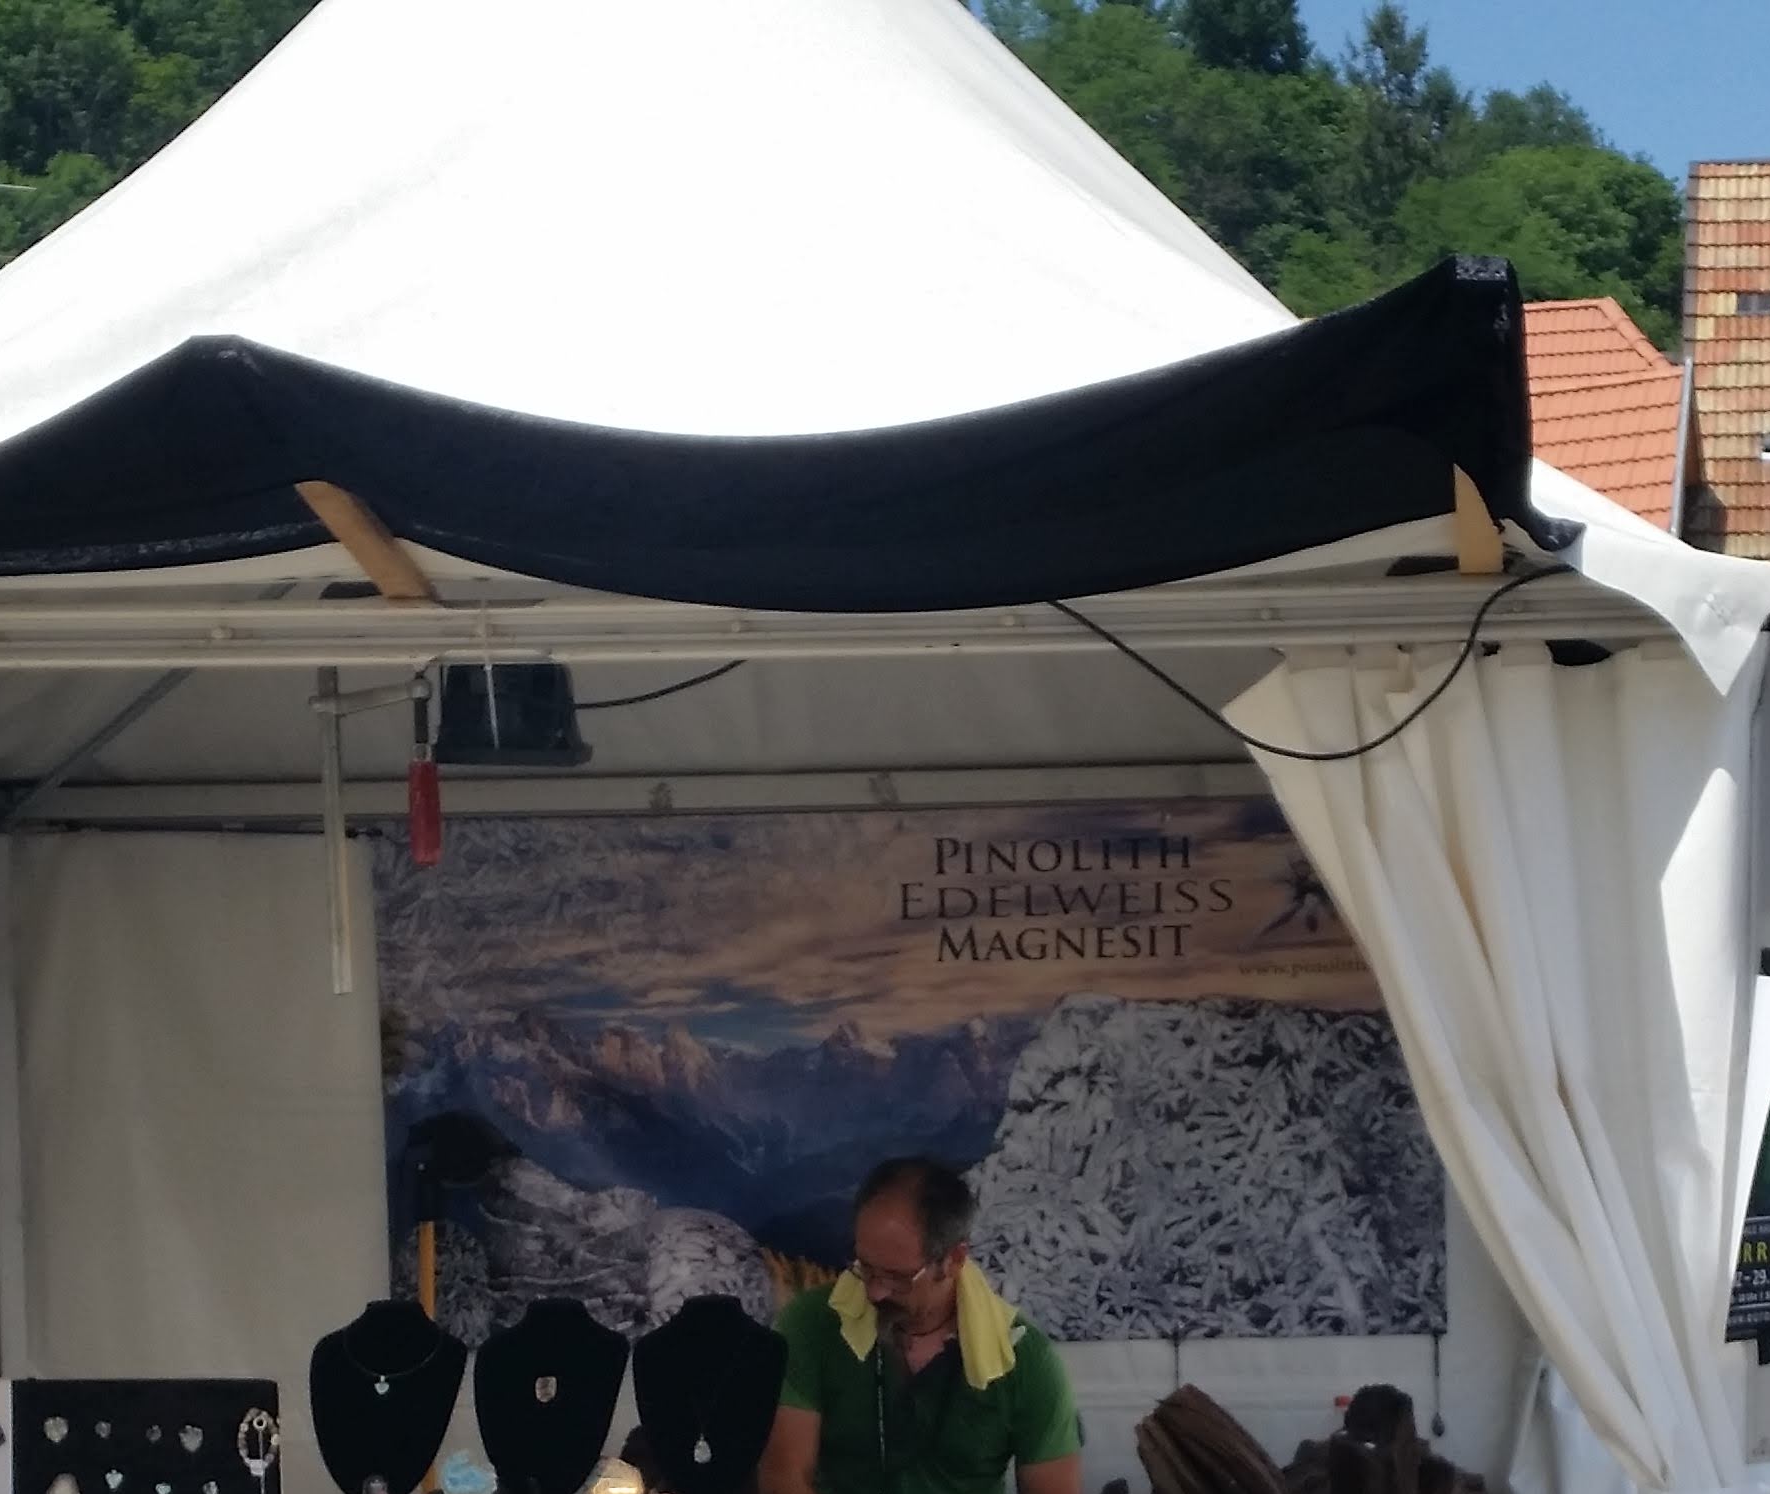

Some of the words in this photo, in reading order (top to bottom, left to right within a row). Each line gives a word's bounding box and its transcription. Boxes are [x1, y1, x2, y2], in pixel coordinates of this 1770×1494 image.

[934, 836, 1191, 874] PINOLITH
[900, 879, 1233, 920] EDELWEISS
[937, 924, 1191, 962] MAGNESIT
